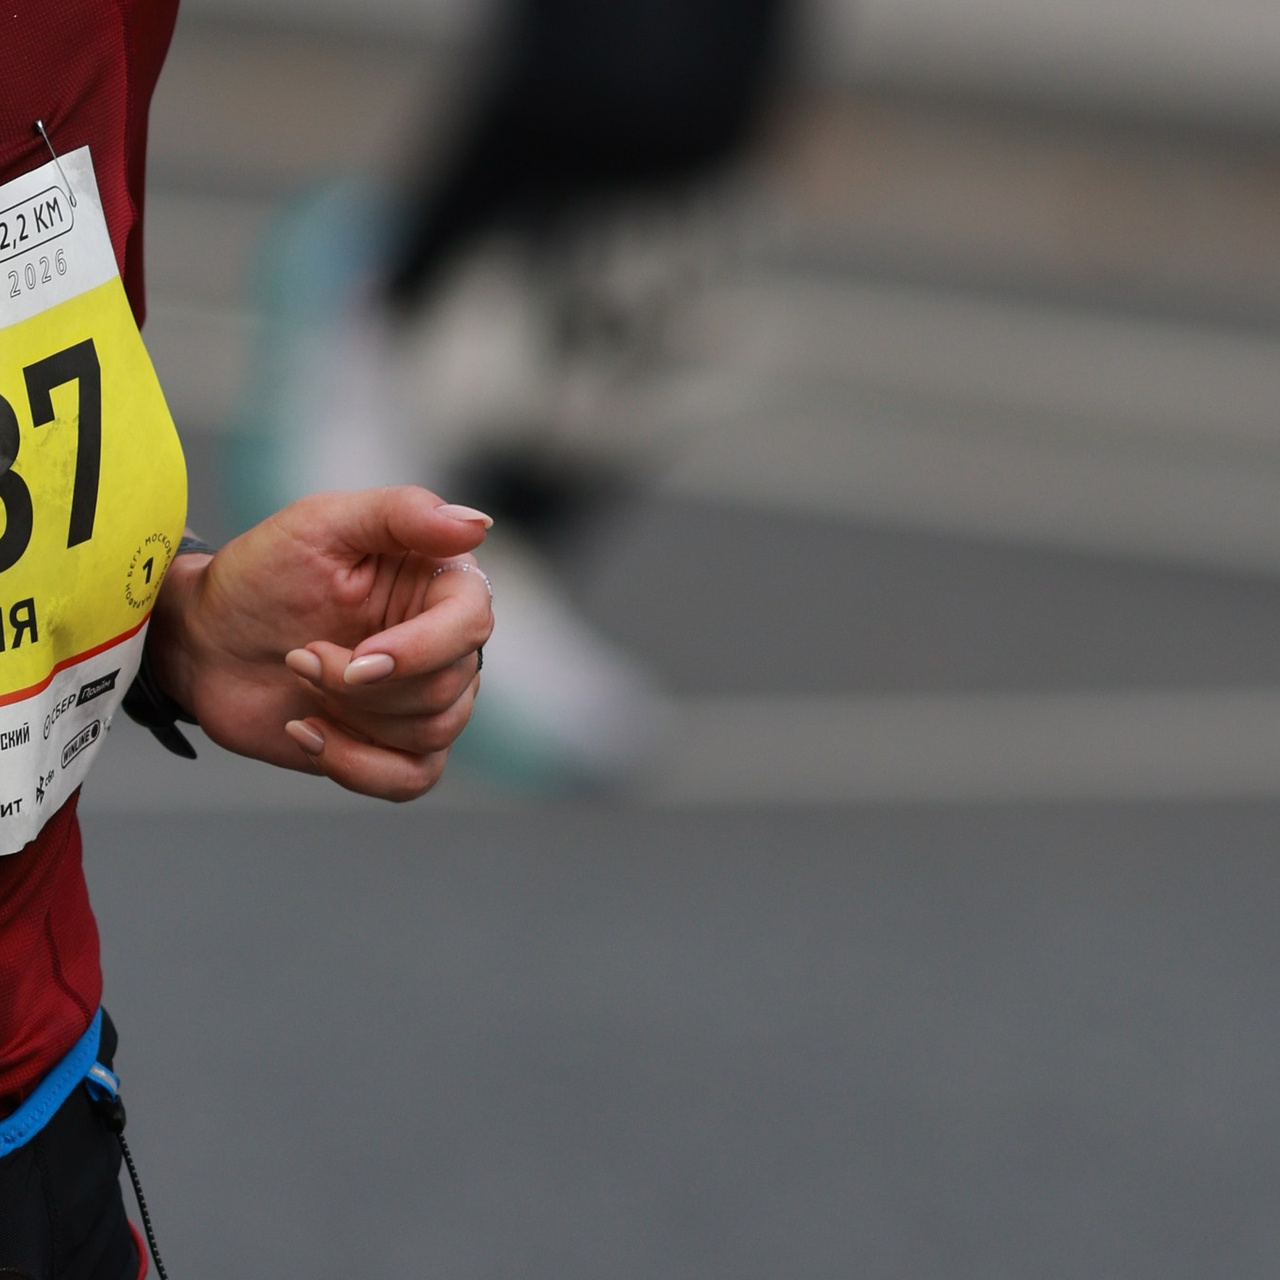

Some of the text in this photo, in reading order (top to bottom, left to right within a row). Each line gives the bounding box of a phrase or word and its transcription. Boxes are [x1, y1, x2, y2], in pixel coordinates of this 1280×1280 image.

[33, 196, 64, 234] КМ
[7, 248, 68, 299] 2026
[142, 556, 155, 585] 1
[51, 693, 77, 725] СБЕР
[63, 728, 91, 765] WINLINE
